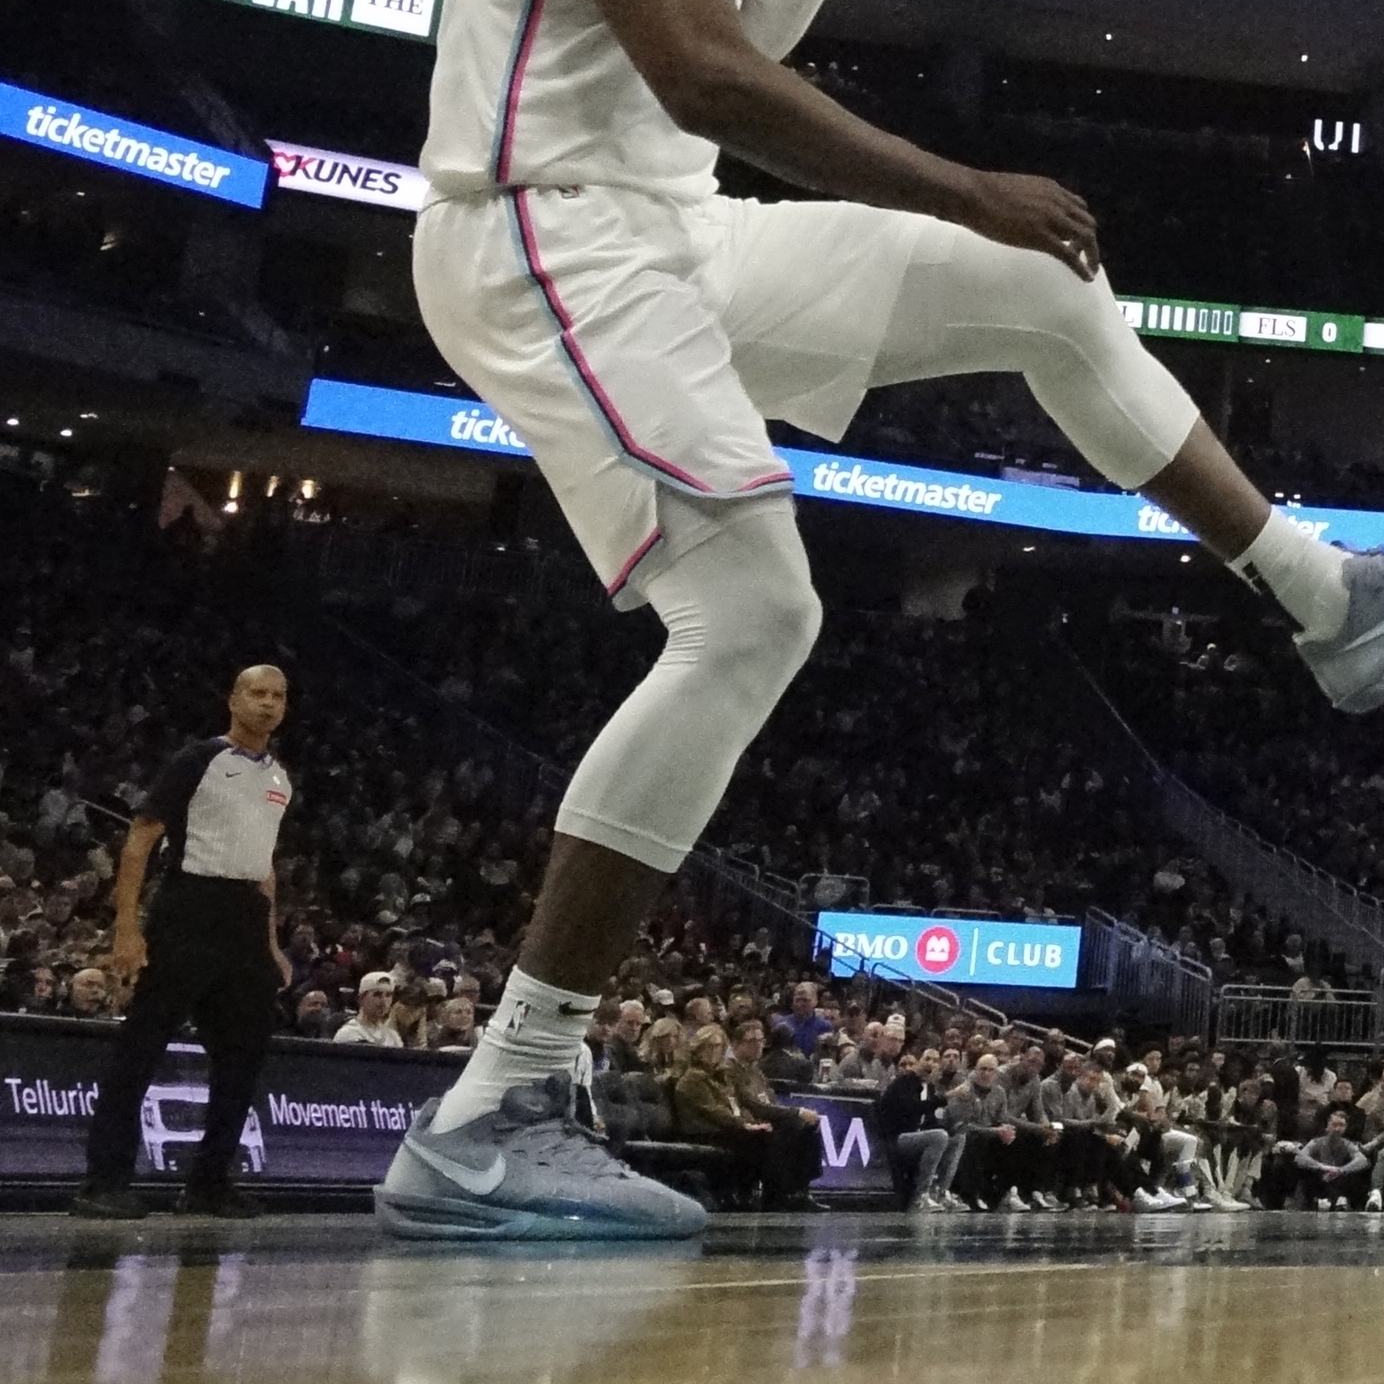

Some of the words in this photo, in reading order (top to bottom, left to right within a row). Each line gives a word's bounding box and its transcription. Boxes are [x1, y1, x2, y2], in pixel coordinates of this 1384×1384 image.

[26, 104, 231, 190] ticketmaster
[291, 154, 402, 195] KUNES
[1258, 317, 1296, 337] FLS
[1322, 322, 1338, 342] 0
[812, 461, 1002, 516] ticketmaster
[834, 932, 908, 959] BMO
[987, 941, 1062, 967] CLUB
[268, 1094, 369, 1129] Movement
[372, 1100, 406, 1130] that
